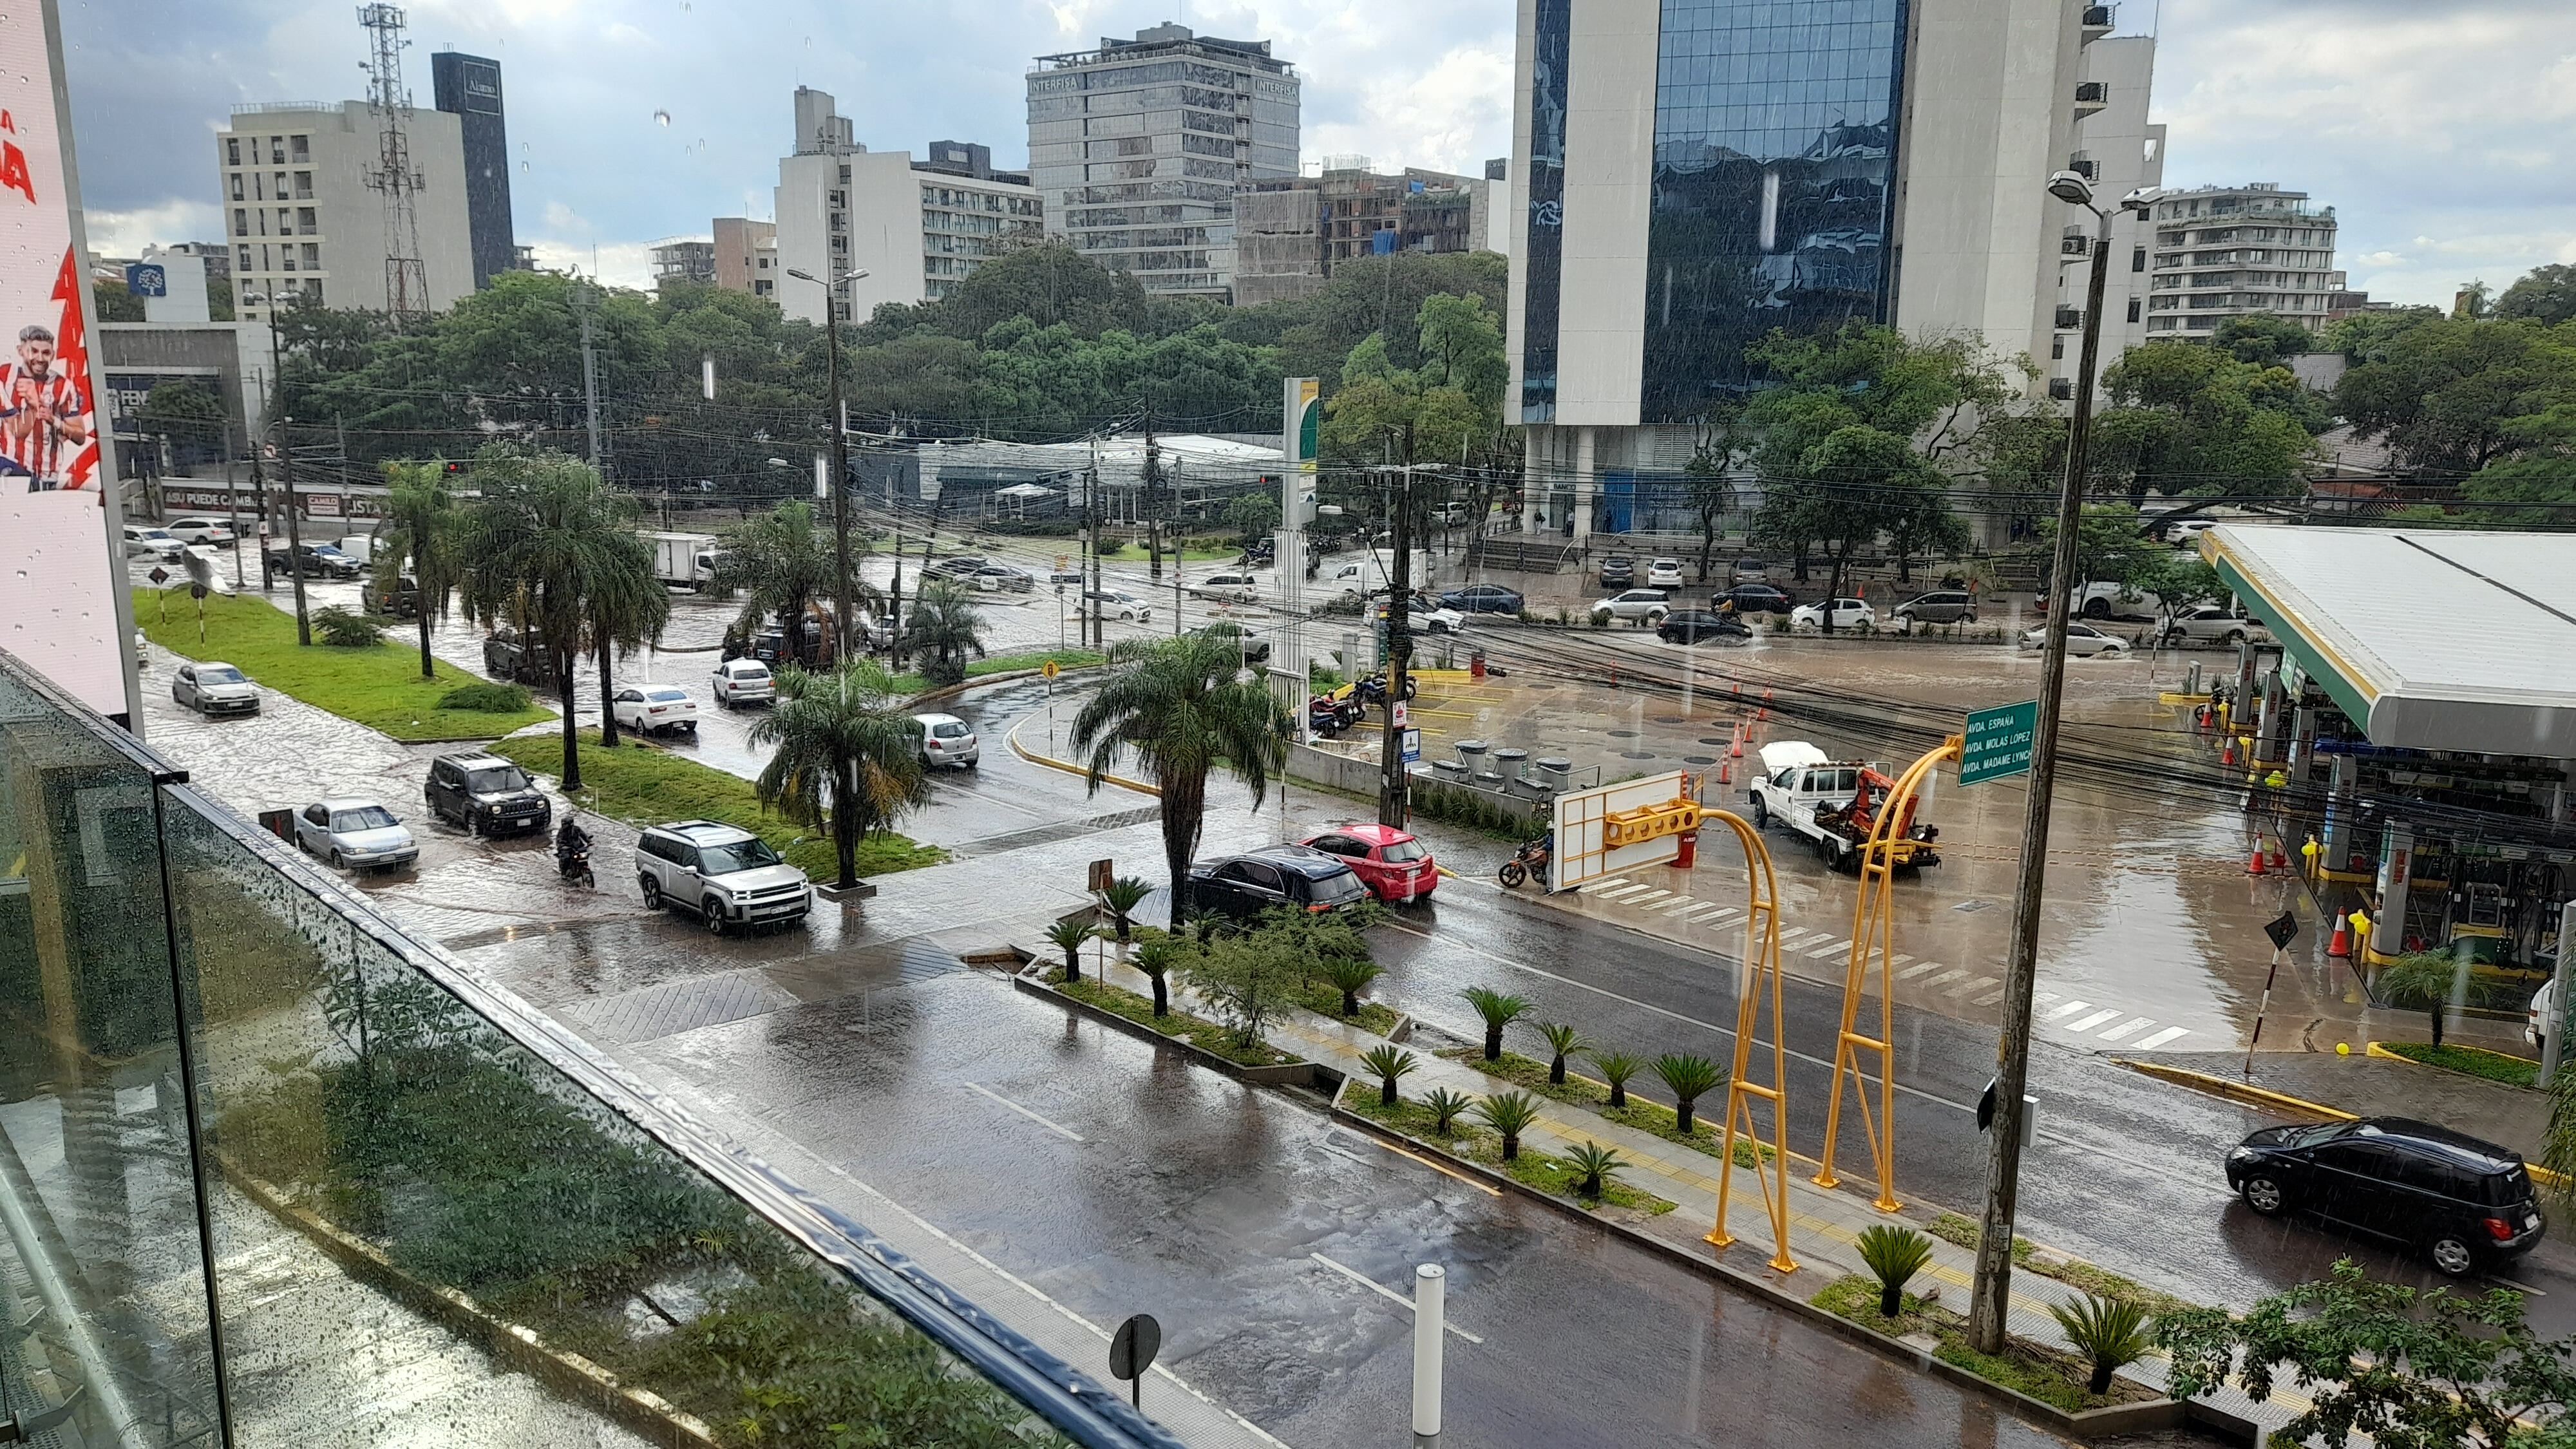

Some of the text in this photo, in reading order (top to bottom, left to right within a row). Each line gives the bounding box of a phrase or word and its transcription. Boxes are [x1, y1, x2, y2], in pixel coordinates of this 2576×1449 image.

[1030, 77, 1077, 91] INTERFISA
[1256, 79, 1298, 98] INTERFISA
[186, 493, 219, 506] PUEDE
[1967, 714, 2014, 734] AVDA. ESPAÑA
[1964, 730, 2031, 755] AVDA. MOLAS LÓPEZ
[1962, 749, 2032, 775] AVDA. MADAME LYNCH
